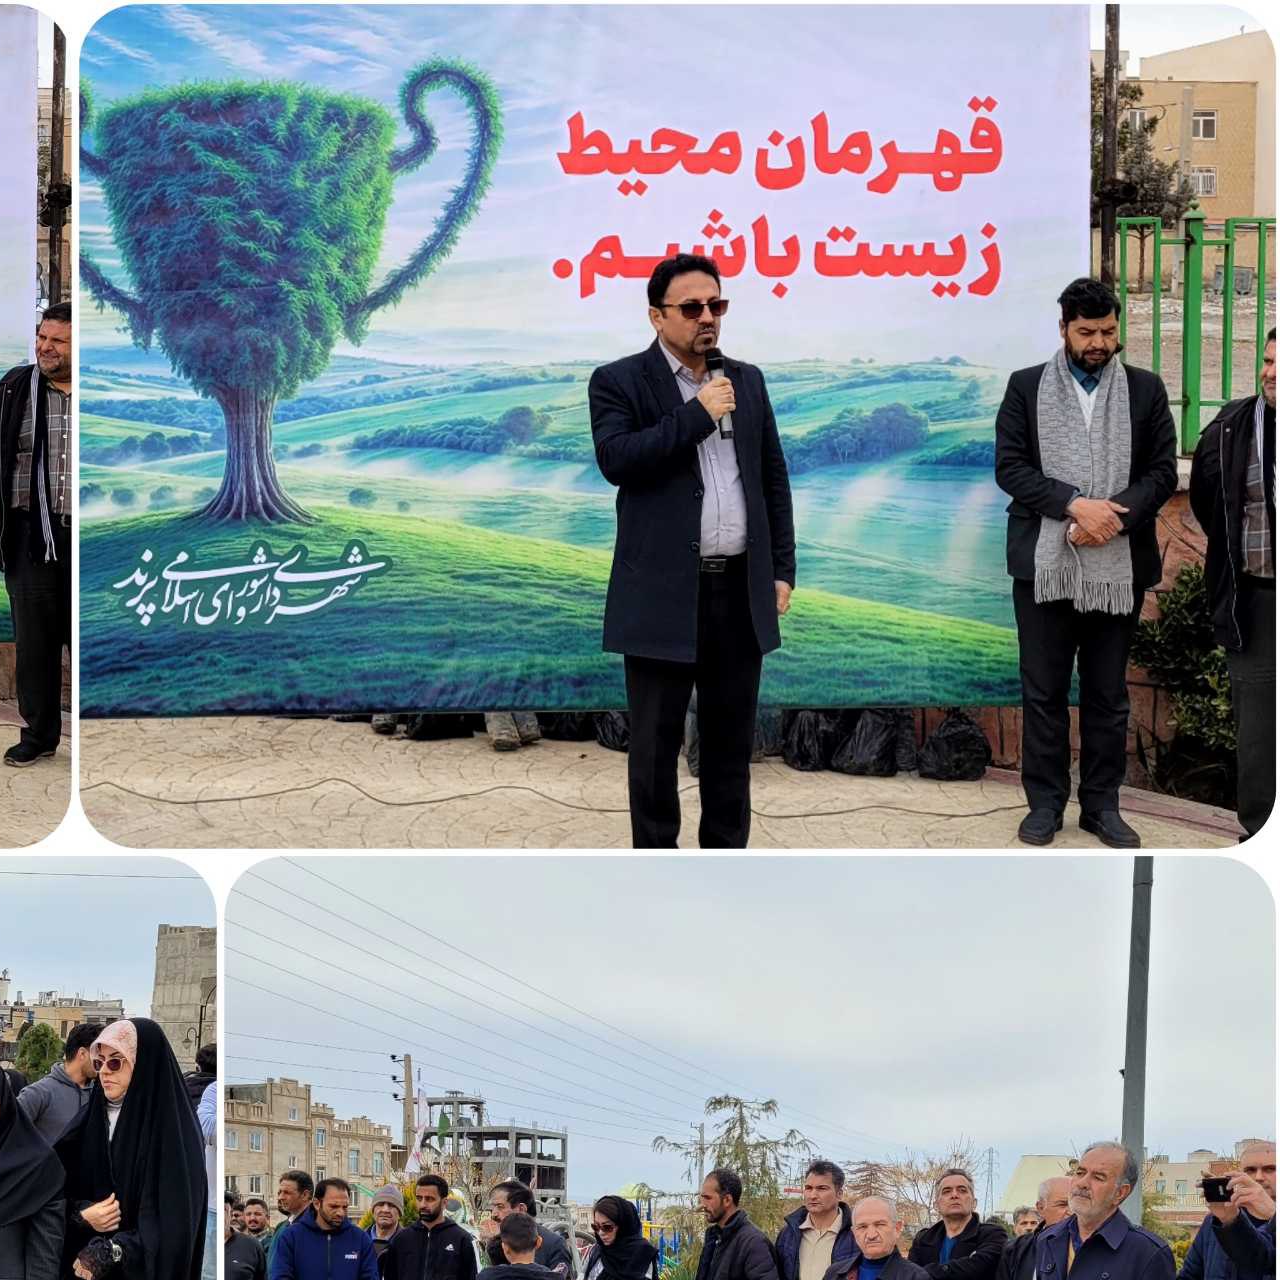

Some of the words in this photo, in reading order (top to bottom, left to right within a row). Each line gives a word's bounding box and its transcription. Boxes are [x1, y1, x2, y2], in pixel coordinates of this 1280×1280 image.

[557, 110, 743, 196] محیط
[754, 95, 1003, 194] قهرمان
[552, 208, 801, 299] باشم.
[813, 222, 1002, 297] زیست
[113, 549, 159, 626] پرند
[249, 546, 386, 625] شهرداری
